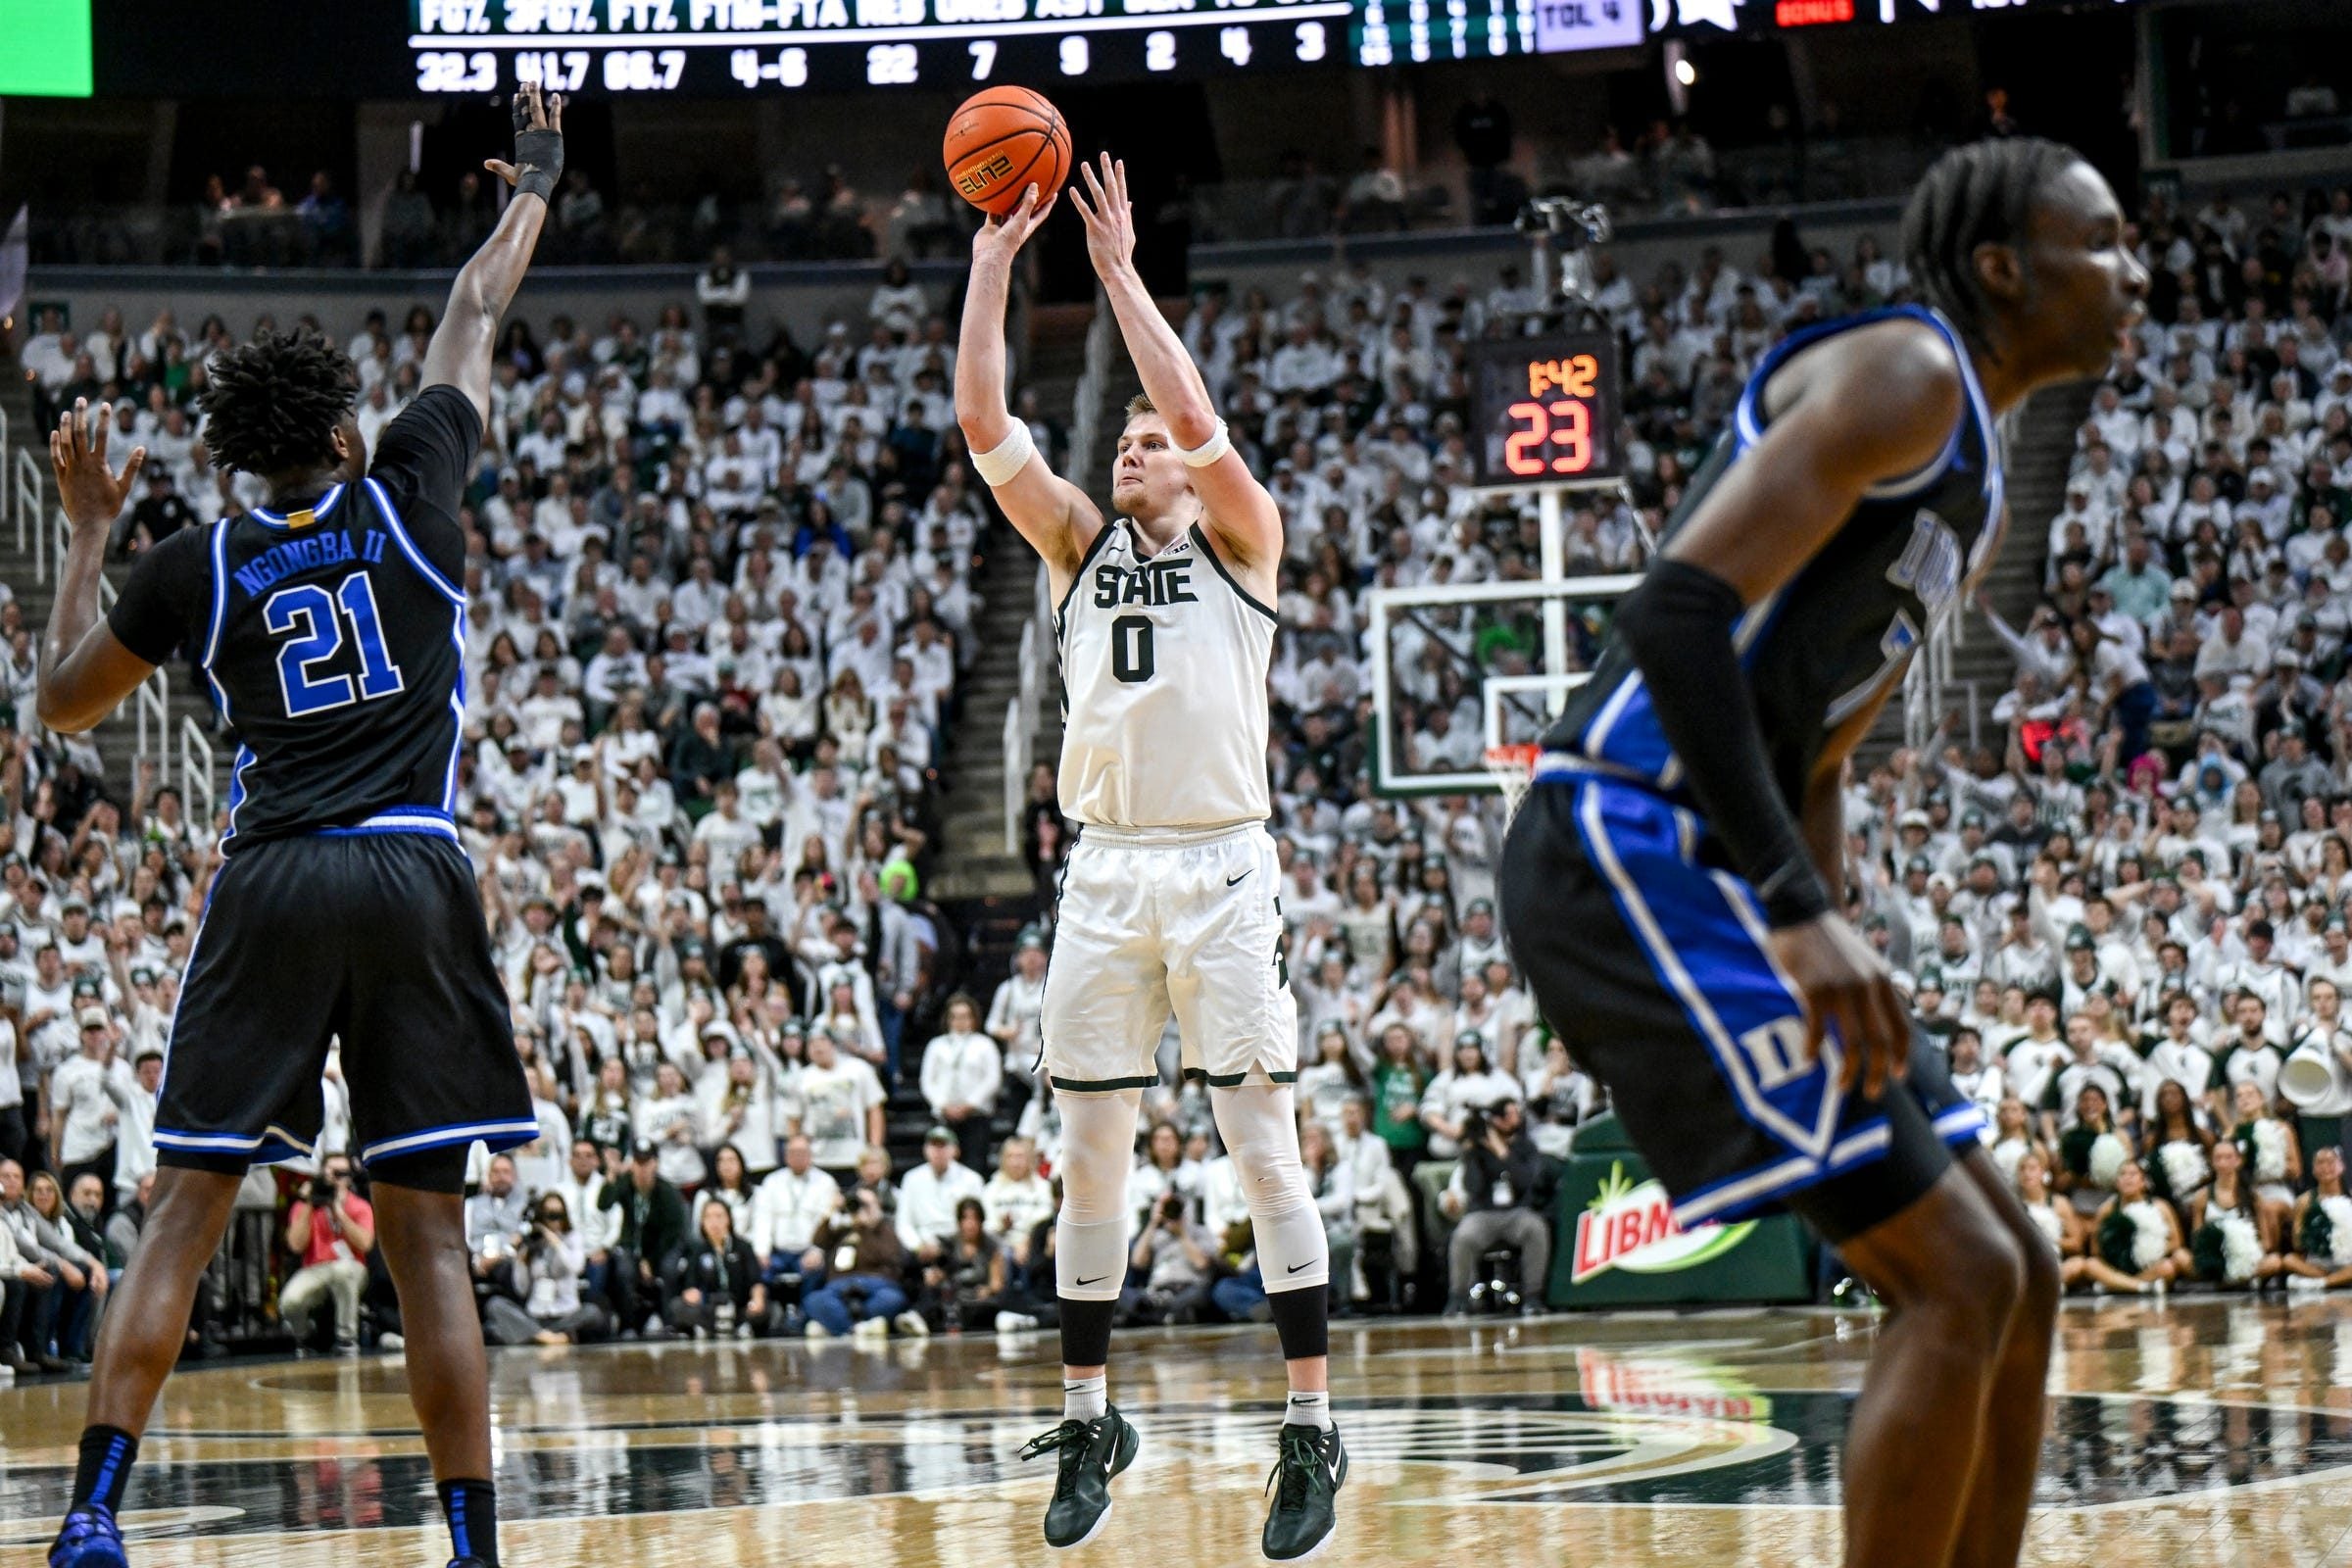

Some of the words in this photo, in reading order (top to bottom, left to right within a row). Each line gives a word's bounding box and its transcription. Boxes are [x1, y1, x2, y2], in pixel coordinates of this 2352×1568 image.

[867, 44, 918, 84] 22
[968, 40, 997, 80] 7
[1146, 30, 1176, 72] 2
[1220, 25, 1251, 66] 4
[1296, 22, 1326, 62] 3
[958, 155, 1015, 195] ELITE
[1505, 400, 1591, 475] 23
[233, 529, 357, 597] NGONGBA
[362, 529, 387, 564] II
[262, 570, 406, 718] 21
[1111, 614, 1155, 683] 0
[1738, 1014, 1816, 1093] D
